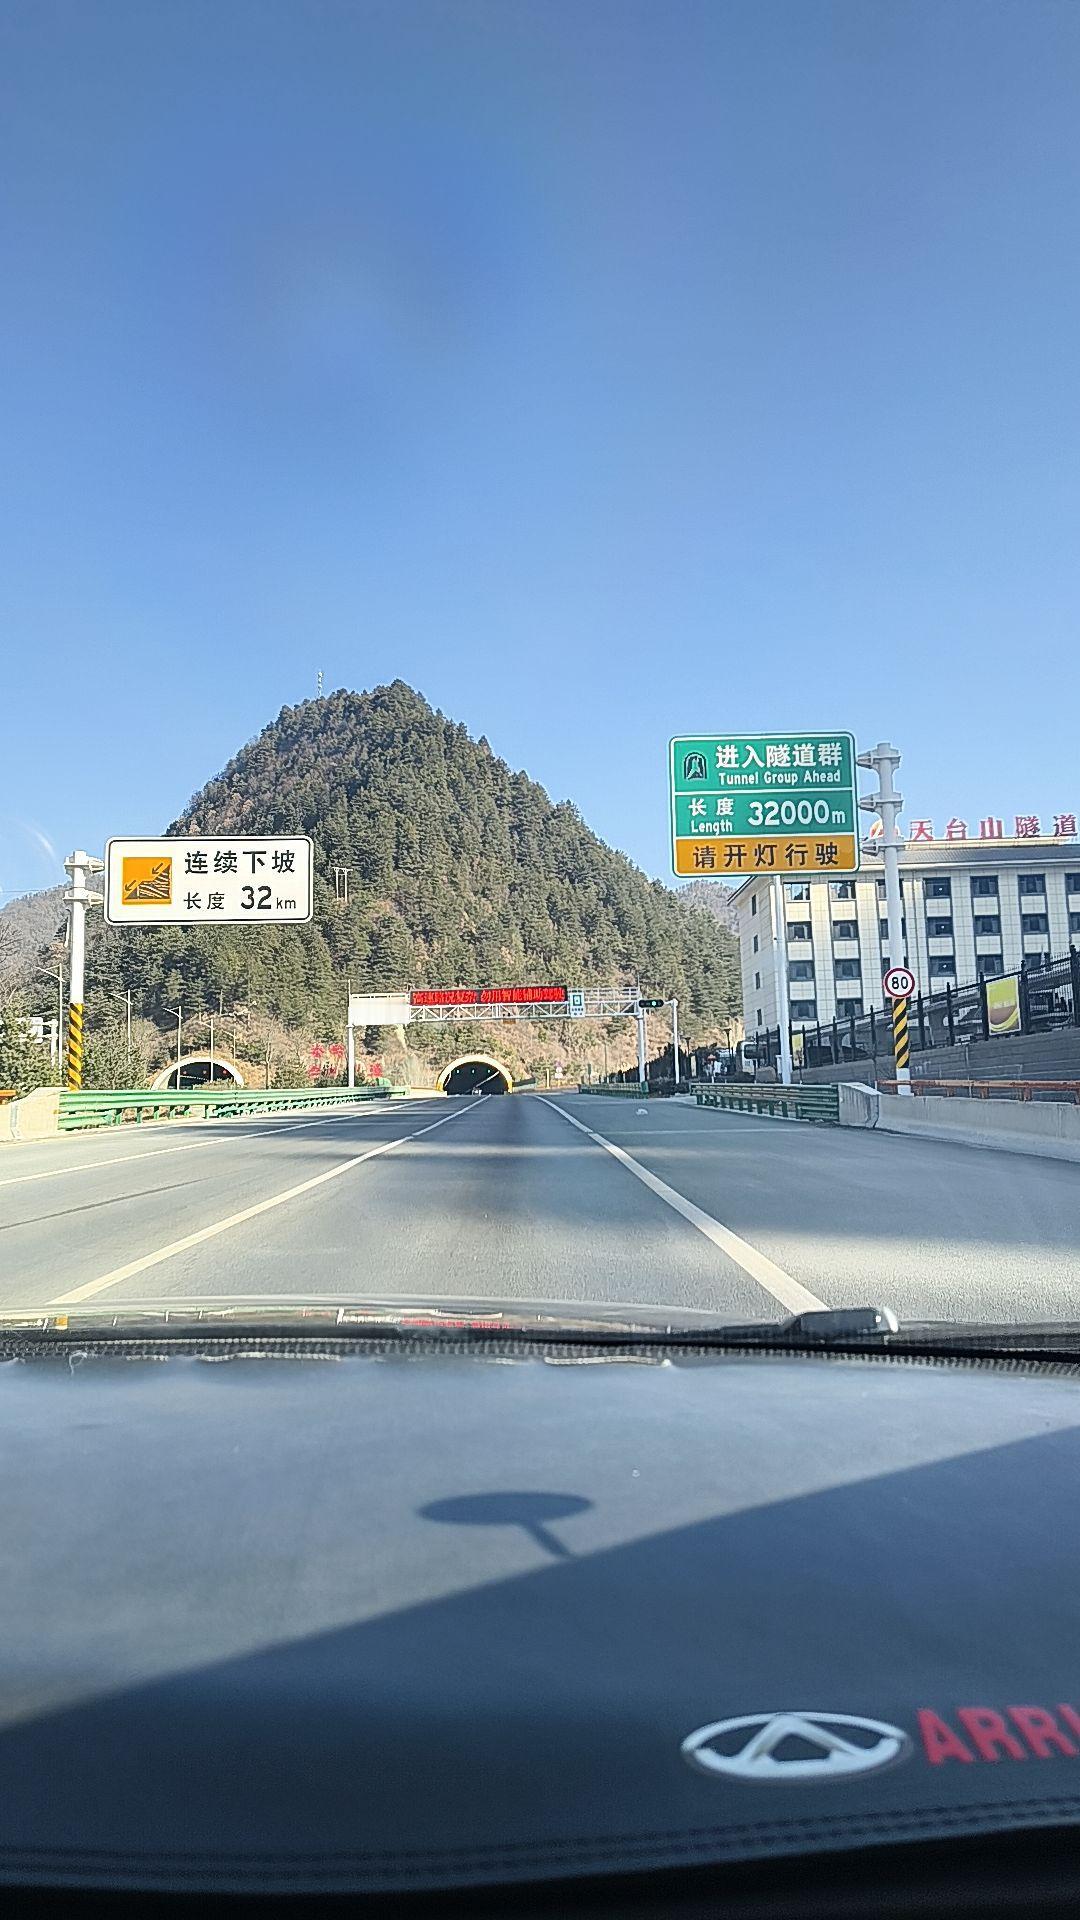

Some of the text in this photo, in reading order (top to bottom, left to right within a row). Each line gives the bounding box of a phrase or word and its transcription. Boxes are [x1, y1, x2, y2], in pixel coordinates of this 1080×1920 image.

[715, 742, 843, 769] 进入隧道群
[719, 769, 841, 786] Tunnel Group Ahead
[688, 797, 735, 817] 长度
[690, 819, 734, 836] Length
[909, 813, 1079, 842] 天台山隧道
[183, 849, 296, 875] 连续下坡
[692, 841, 840, 869] 请开灯行驶
[183, 891, 226, 910] 长度
[891, 976, 909, 990] 80
